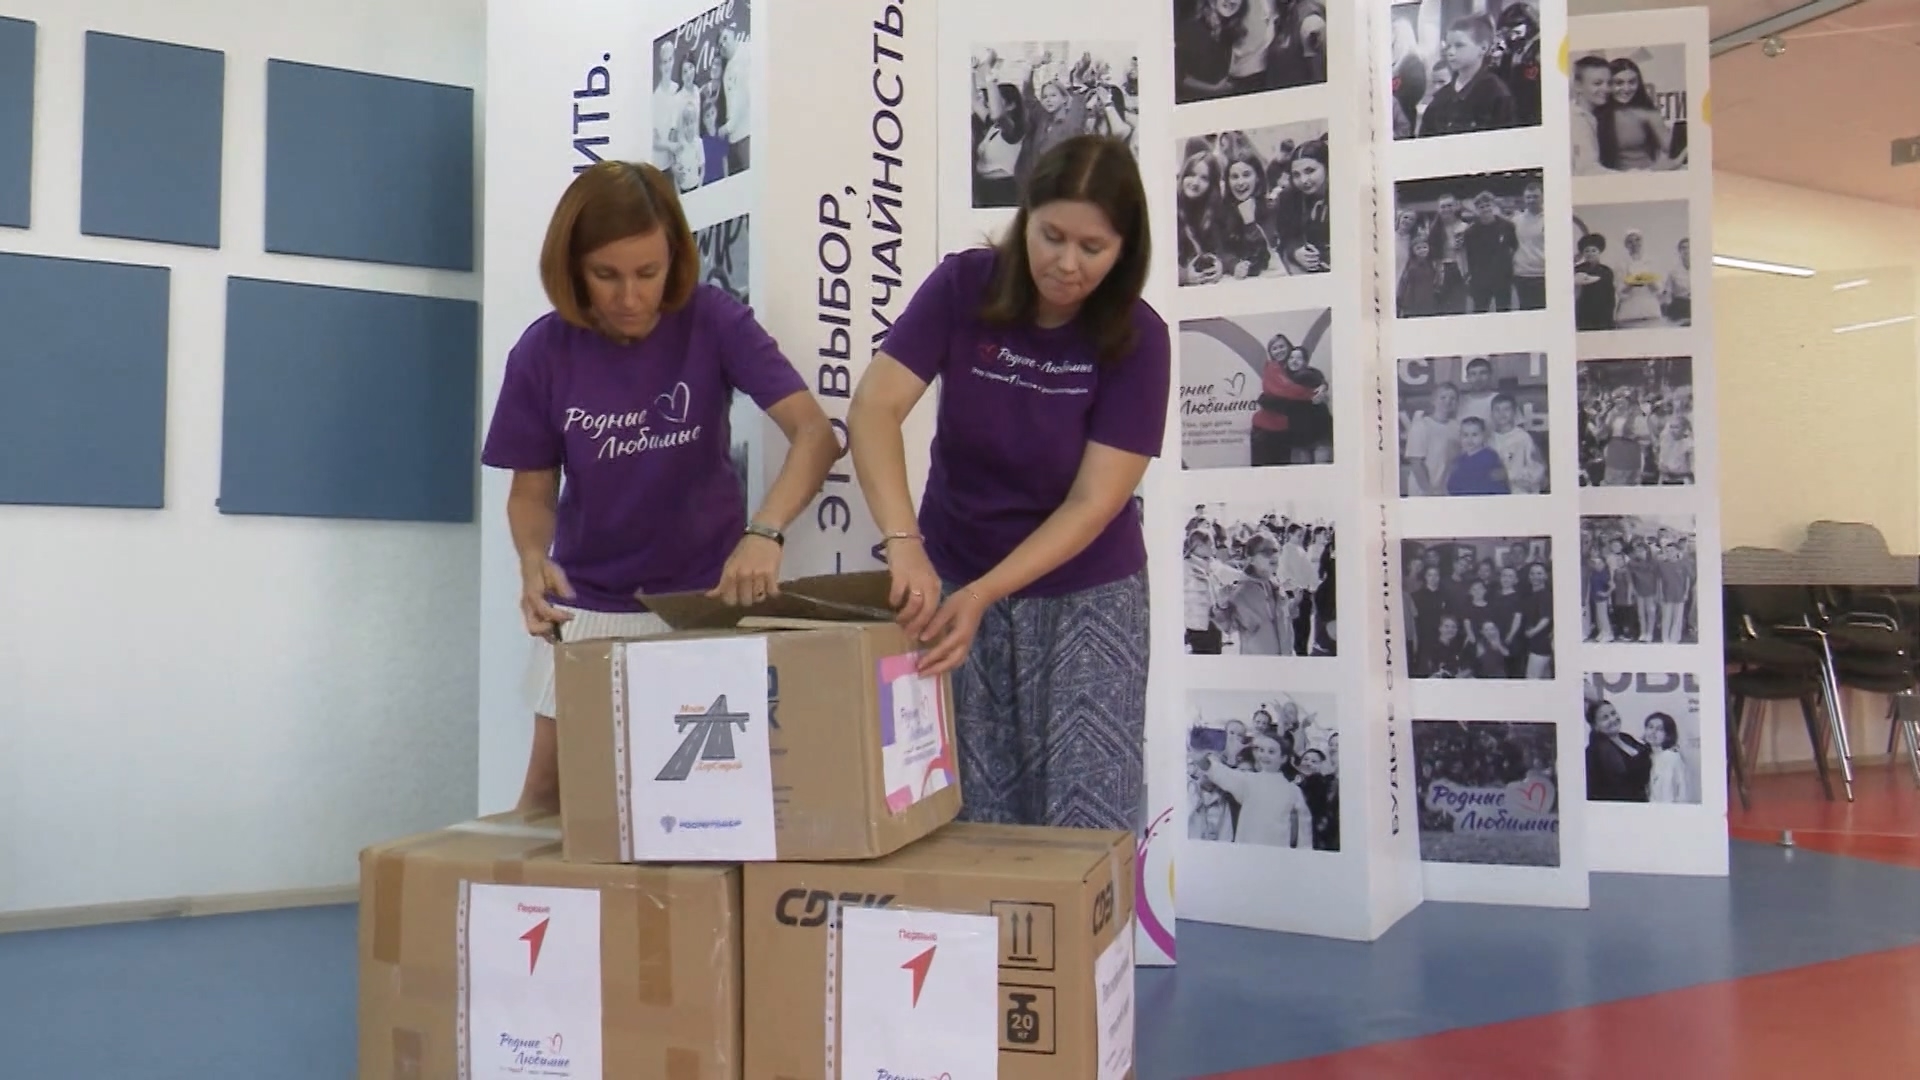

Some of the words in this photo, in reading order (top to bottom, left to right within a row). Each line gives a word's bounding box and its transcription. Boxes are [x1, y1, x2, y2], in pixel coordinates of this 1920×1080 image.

[818, 186, 858, 399] ВЫБОР,
[564, 406, 648, 439] Родные
[597, 424, 701, 460] Любимые
[1432, 784, 1505, 812] Родные
[1011, 1014, 1034, 1030] 20
